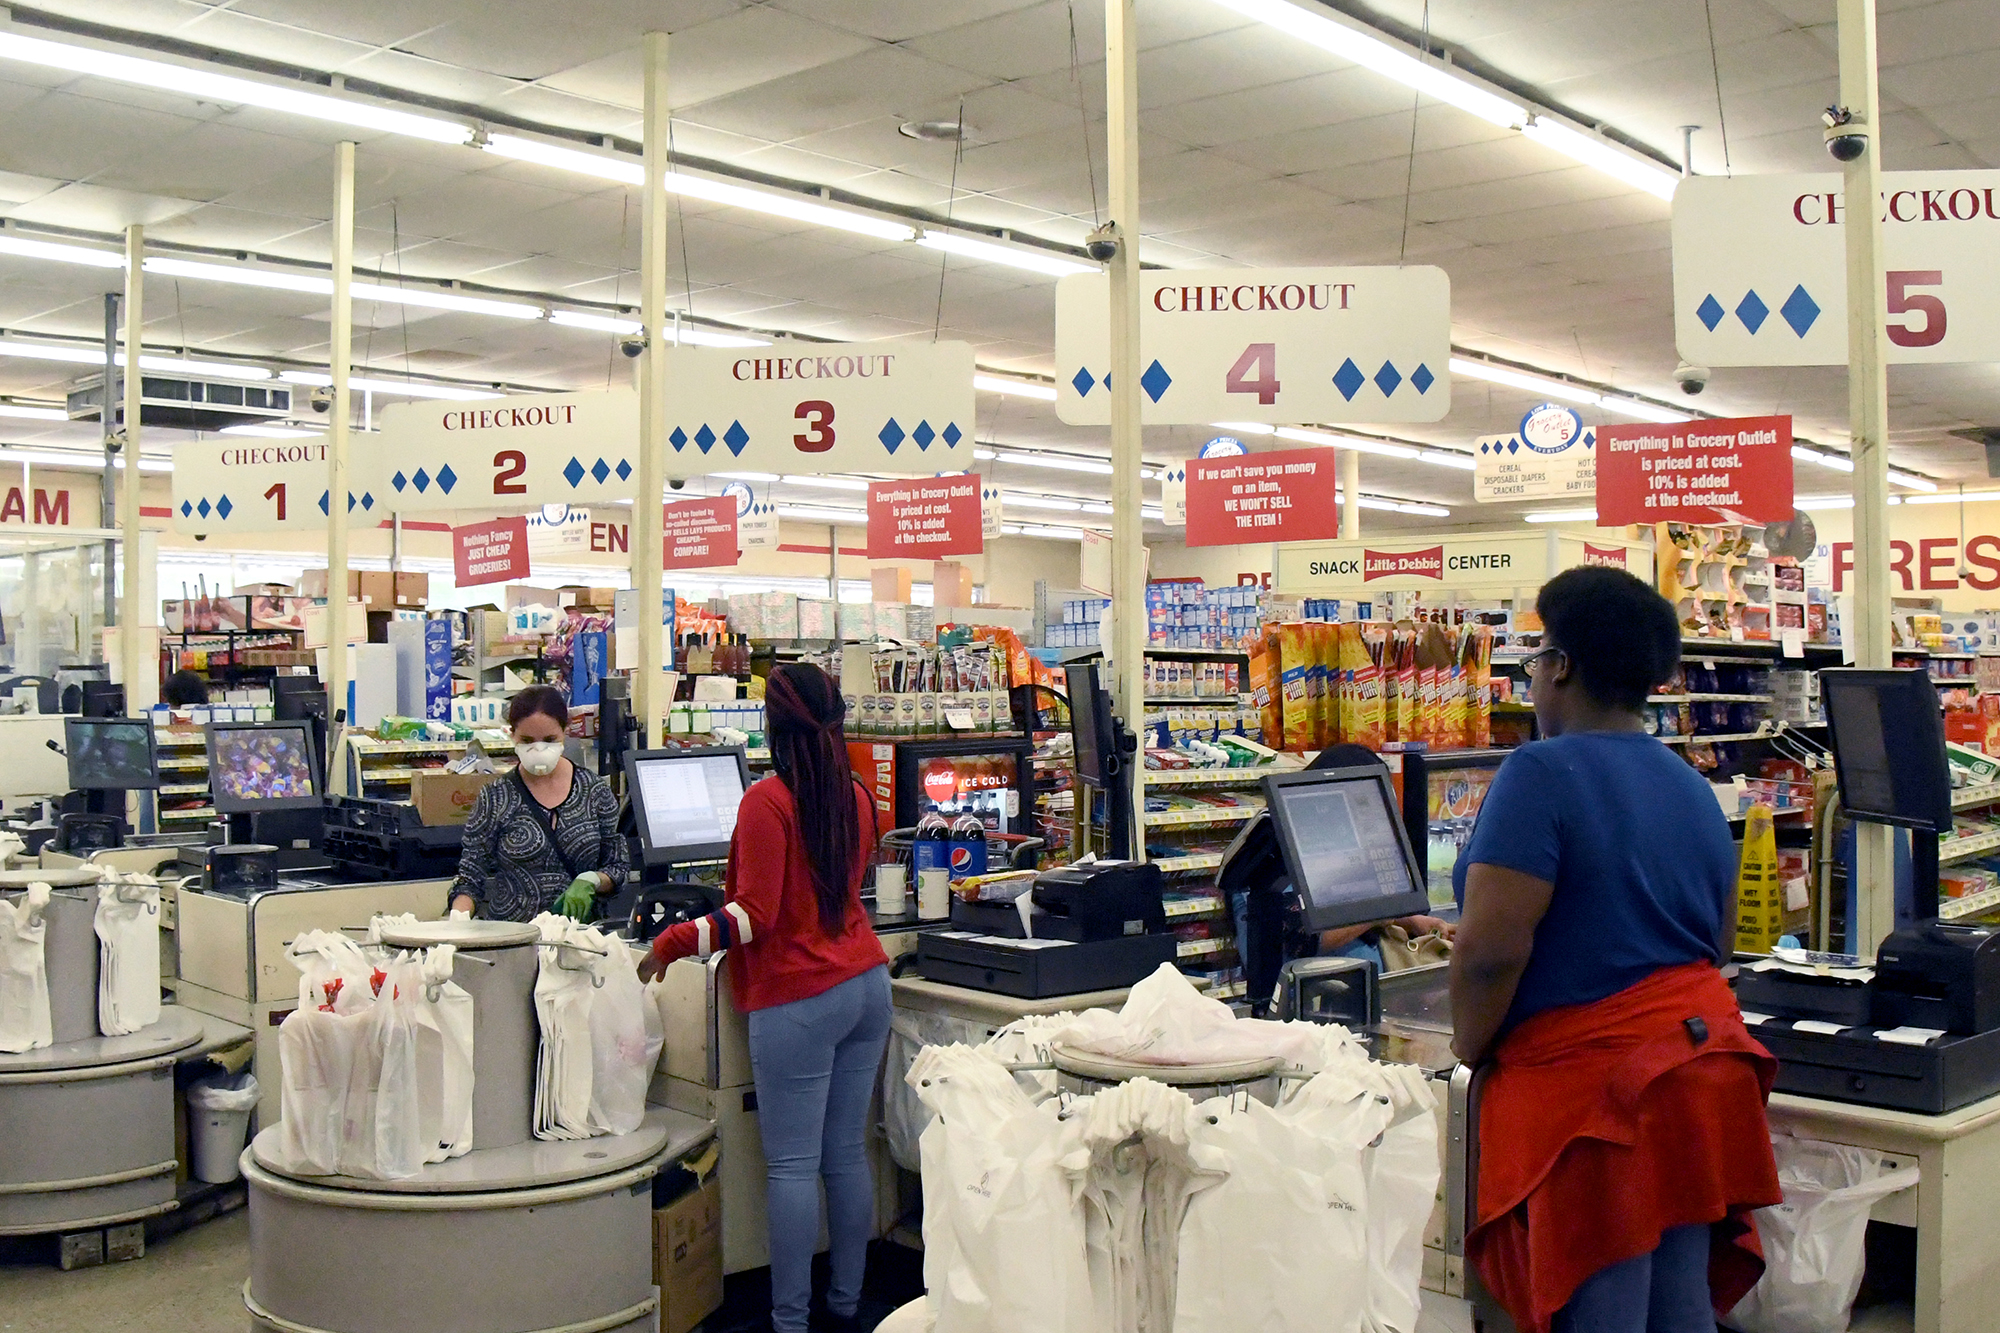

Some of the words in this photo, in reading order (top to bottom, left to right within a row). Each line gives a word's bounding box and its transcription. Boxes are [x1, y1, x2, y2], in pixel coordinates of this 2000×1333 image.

[1793, 188, 2000, 225] CHCKOU
[1154, 284, 1355, 312] CHECKOUT
[1886, 270, 1947, 347] 5
[733, 355, 895, 381] CHECKOUT
[1226, 343, 1280, 404] 4
[443, 405, 576, 430] CHECKOUT
[1531, 405, 1544, 415] LOW
[794, 400, 835, 453] 3
[1528, 412, 1562, 432] Grocery
[1543, 418, 1571, 433] Outlet
[1561, 429, 1569, 440] 5
[1610, 436, 1669, 453] Everything
[1672, 435, 1683, 449] in
[1687, 433, 1735, 449] Grocery
[1738, 430, 1777, 446] Outlet
[221, 445, 329, 465] CHECKOUT
[1534, 443, 1568, 454] EVERYDAY
[1499, 464, 1521, 473] CEREAL
[1578, 459, 1590, 467] HOT
[1642, 457, 1652, 471] is
[1655, 455, 1692, 473] priced
[1696, 455, 1708, 469] at
[1711, 453, 1742, 468] cost.
[494, 450, 526, 494] 2
[1199, 469, 1204, 480] If
[1206, 470, 1219, 479] we
[1220, 465, 1242, 478] can't
[1244, 466, 1264, 477] save
[1266, 466, 1283, 478] you
[1285, 463, 1316, 475] money
[1484, 475, 1518, 485] DISPOSABLE
[1521, 473, 1546, 482] DIAPERS
[1576, 470, 1596, 478] CEREA
[1232, 485, 1243, 494] on
[1245, 484, 1256, 494] an
[1258, 481, 1281, 494] item,
[1566, 482, 1581, 490] BABY
[1584, 480, 1596, 488] FOO
[1648, 475, 1674, 489] 10%
[1676, 475, 1687, 489] is
[1691, 473, 1729, 488] added
[876, 490, 911, 503] Everything
[913, 489, 919, 499] in
[921, 487, 949, 499] Grocery
[951, 485, 973, 497] Outlet
[1493, 485, 1524, 494] CRACKERS
[264, 483, 286, 520] 1
[1224, 500, 1238, 512] WE
[1240, 498, 1268, 511] WON'T
[1270, 496, 1292, 508] SELL
[1645, 494, 1657, 507] at
[1659, 493, 1679, 506] the
[1682, 491, 1742, 506] checkout.
[893, 506, 899, 517] is
[901, 505, 922, 518] priced
[924, 505, 932, 515] at
[933, 503, 951, 514] cost.
[898, 520, 912, 530] 10%
[914, 519, 920, 529] is
[922, 518, 945, 529] added
[1235, 516, 1252, 528] THE
[1254, 515, 1276, 526] ITEM
[673, 528, 688, 536] SELLS
[690, 526, 703, 535] LAYS
[704, 524, 731, 533] PRODUCTS
[895, 535, 902, 544] at
[903, 533, 915, 543] the
[916, 531, 952, 543] checkout.
[464, 533, 489, 547] Nothing
[491, 530, 513, 543] Fancy
[468, 548, 485, 560] JUST
[486, 544, 510, 557] CHEAP
[674, 545, 709, 557] COMPARE!
[469, 559, 511, 575] GROCERIES!
[1309, 561, 1359, 575] SNACK
[1366, 558, 1396, 572] Little
[1398, 557, 1440, 571] Debbie
[1448, 554, 1511, 570] CENTER
[925, 771, 954, 786] Coca-Cola
[961, 779, 977, 787] ICE
[982, 775, 1008, 786] COLD
[1744, 889, 1758, 897] WET
[1740, 899, 1761, 907] FLOOR
